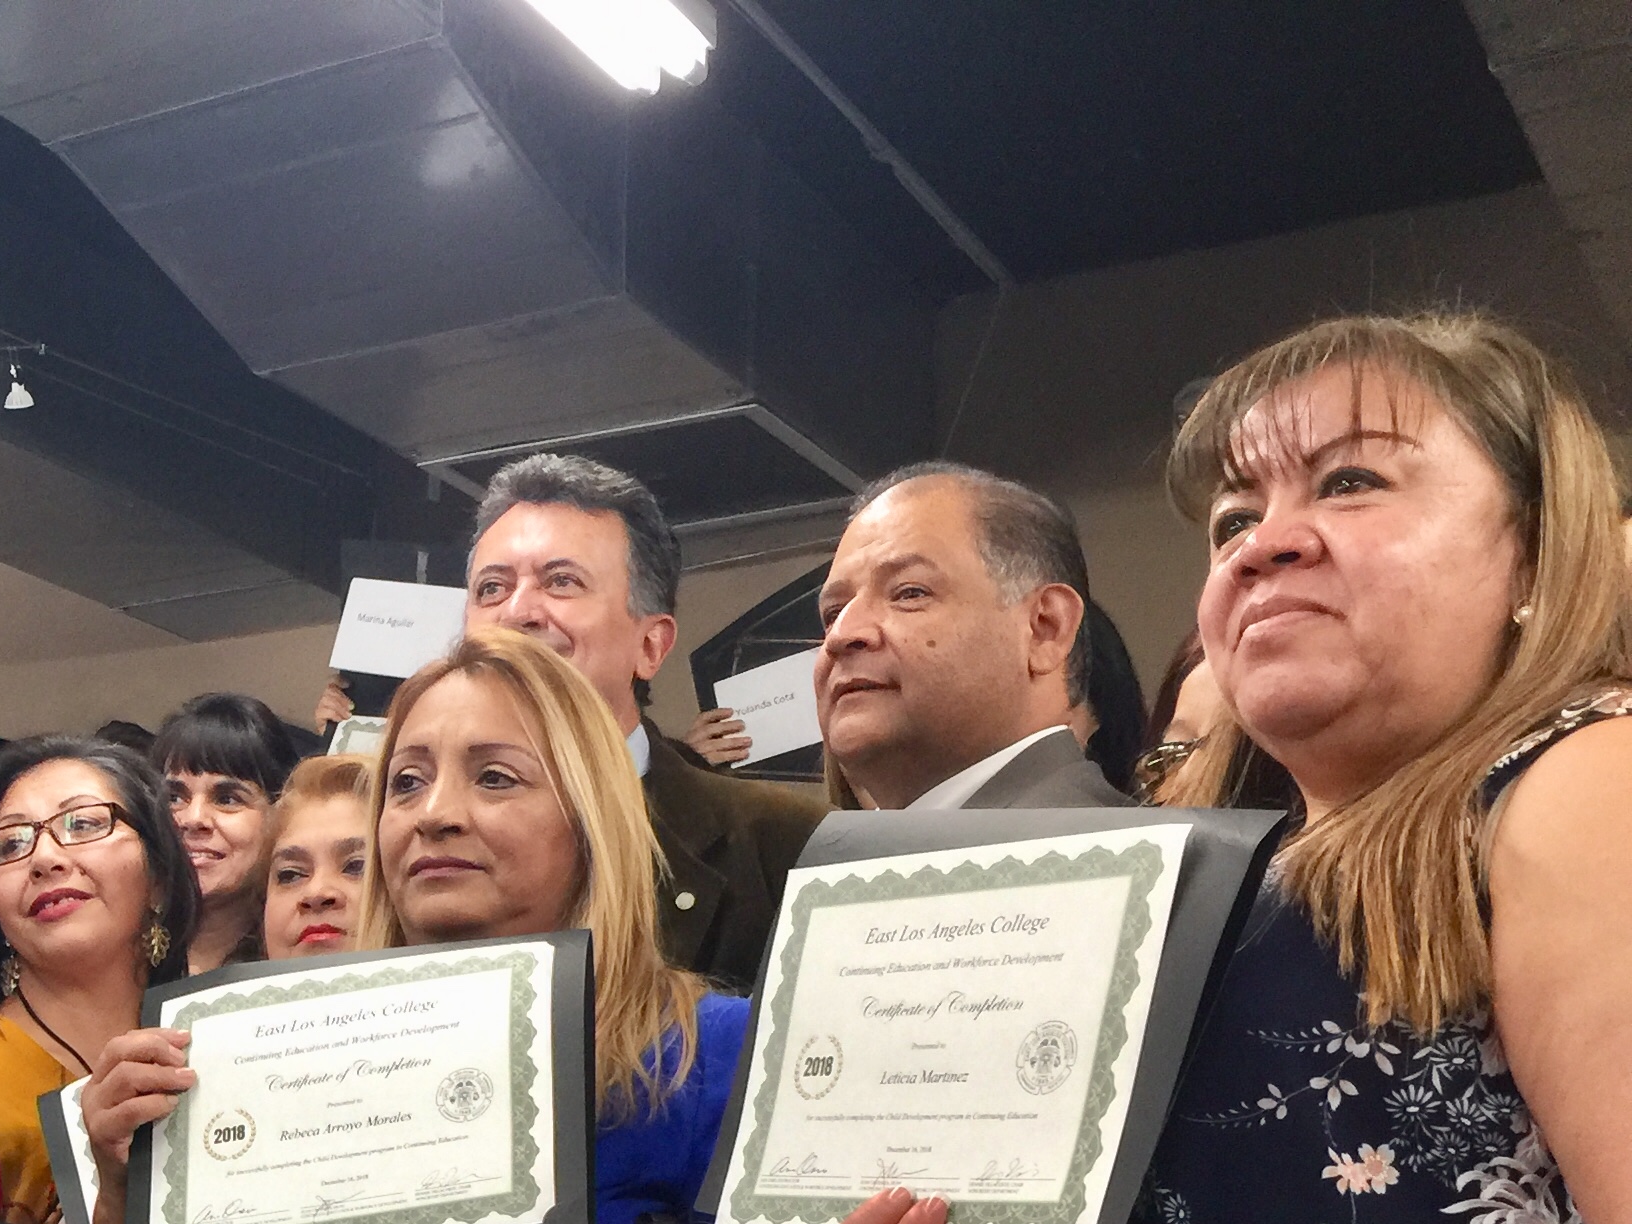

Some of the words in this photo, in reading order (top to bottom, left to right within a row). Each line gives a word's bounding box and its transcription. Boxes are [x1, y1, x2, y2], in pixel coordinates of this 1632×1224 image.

[357, 612, 385, 625] Marina
[865, 927, 897, 944] East
[899, 925, 925, 941] Los
[927, 918, 985, 942] Angeles
[991, 914, 1049, 935] College
[838, 966, 886, 977] Continuing
[887, 962, 931, 973] Education
[932, 958, 951, 970] and
[953, 956, 999, 969] Workforce
[1001, 953, 1064, 965] Development
[255, 1024, 286, 1037] East
[291, 1020, 314, 1032] Los
[320, 1009, 375, 1026] Angeles
[383, 1001, 437, 1016] College
[861, 996, 926, 1021] Certificate
[925, 996, 943, 1020] of
[947, 991, 1023, 1020] Completion
[234, 1052, 281, 1065] Continuing
[285, 1044, 329, 1056] Education
[332, 1038, 349, 1047] and
[352, 1033, 397, 1043] Workforce
[401, 1021, 459, 1036] Development
[265, 1073, 333, 1091] Certificate
[336, 1067, 351, 1083] of
[353, 1057, 431, 1078] Completion
[803, 1056, 834, 1077] 2018
[879, 1071, 917, 1084] Leticia
[213, 1124, 246, 1144] 2018
[280, 1128, 319, 1141] Rebeca
[323, 1122, 362, 1133] Arroyo
[366, 1112, 411, 1127] Morales
